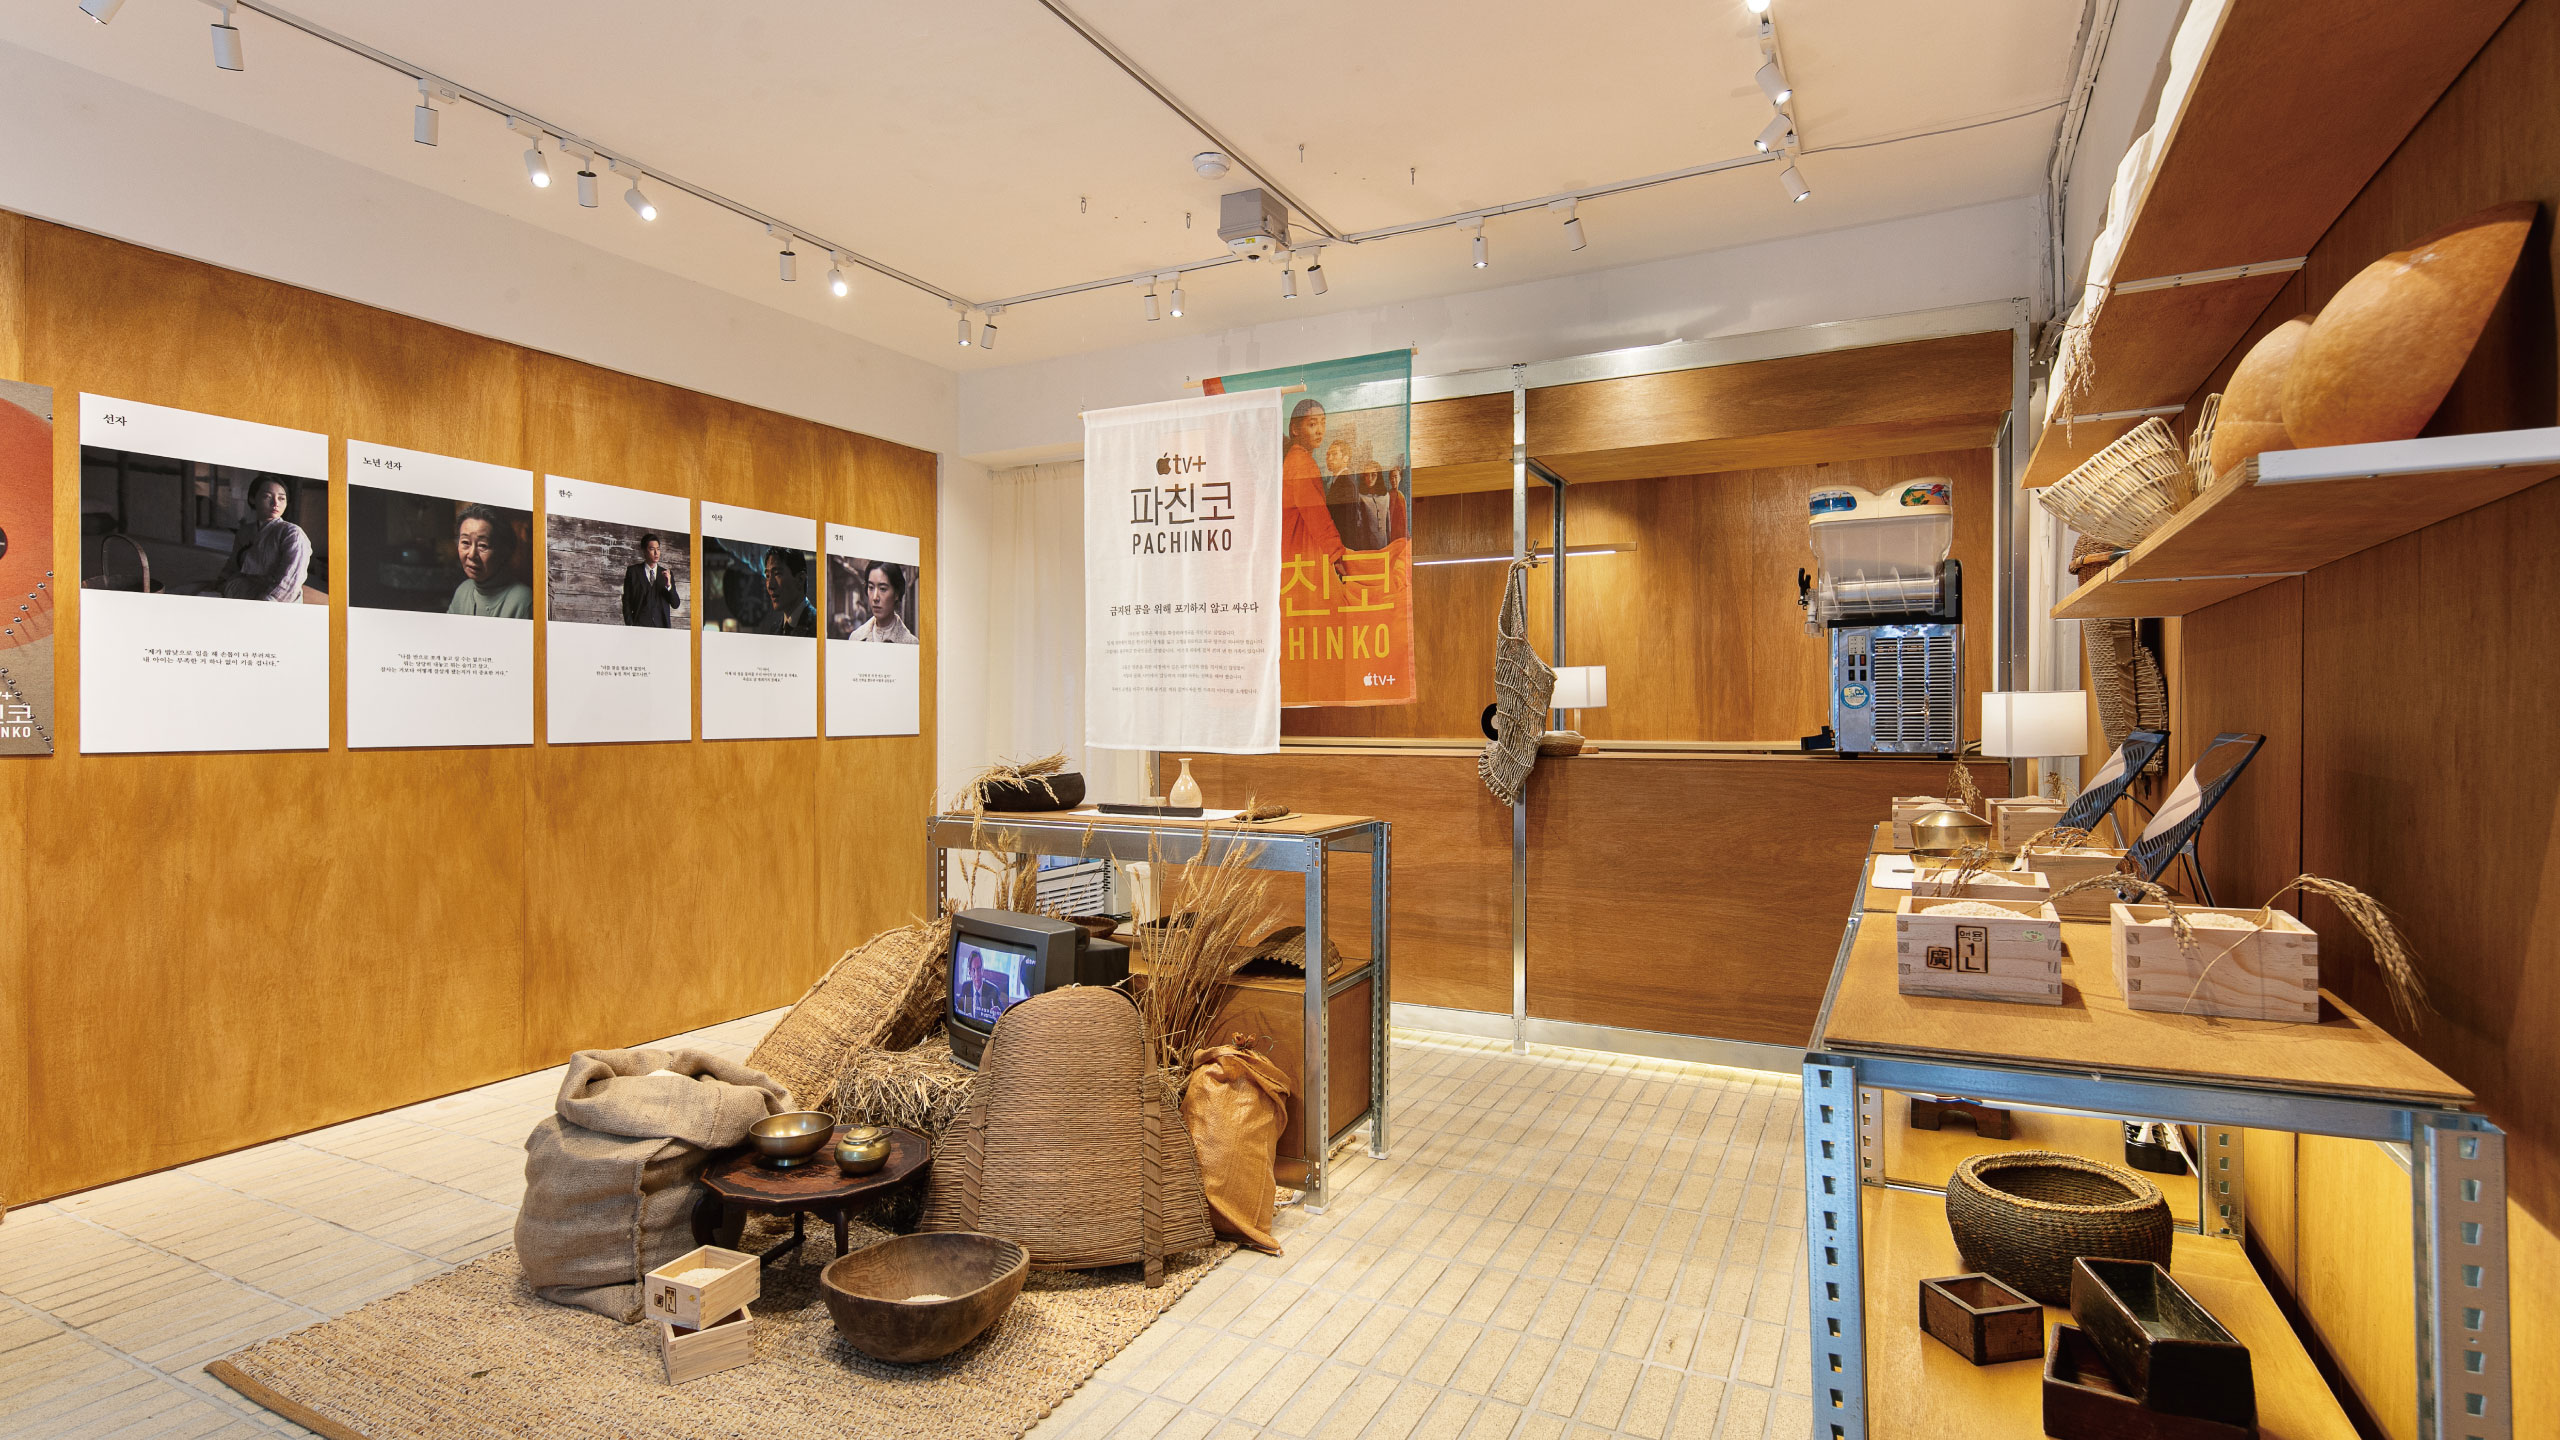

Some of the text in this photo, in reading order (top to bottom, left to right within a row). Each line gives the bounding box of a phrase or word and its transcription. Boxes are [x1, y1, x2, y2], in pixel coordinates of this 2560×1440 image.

[103, 413, 128, 427] 선자
[362, 456, 403, 471] 노년 선자
[558, 489, 573, 499] 한수
[1130, 481, 1236, 526] 파친코
[1132, 528, 1232, 555] PACHINKO
[1109, 601, 1259, 617] 금지된 꿈을 위해 포기하지 않고 싸우다
[1372, 672, 1396, 687] tv+
